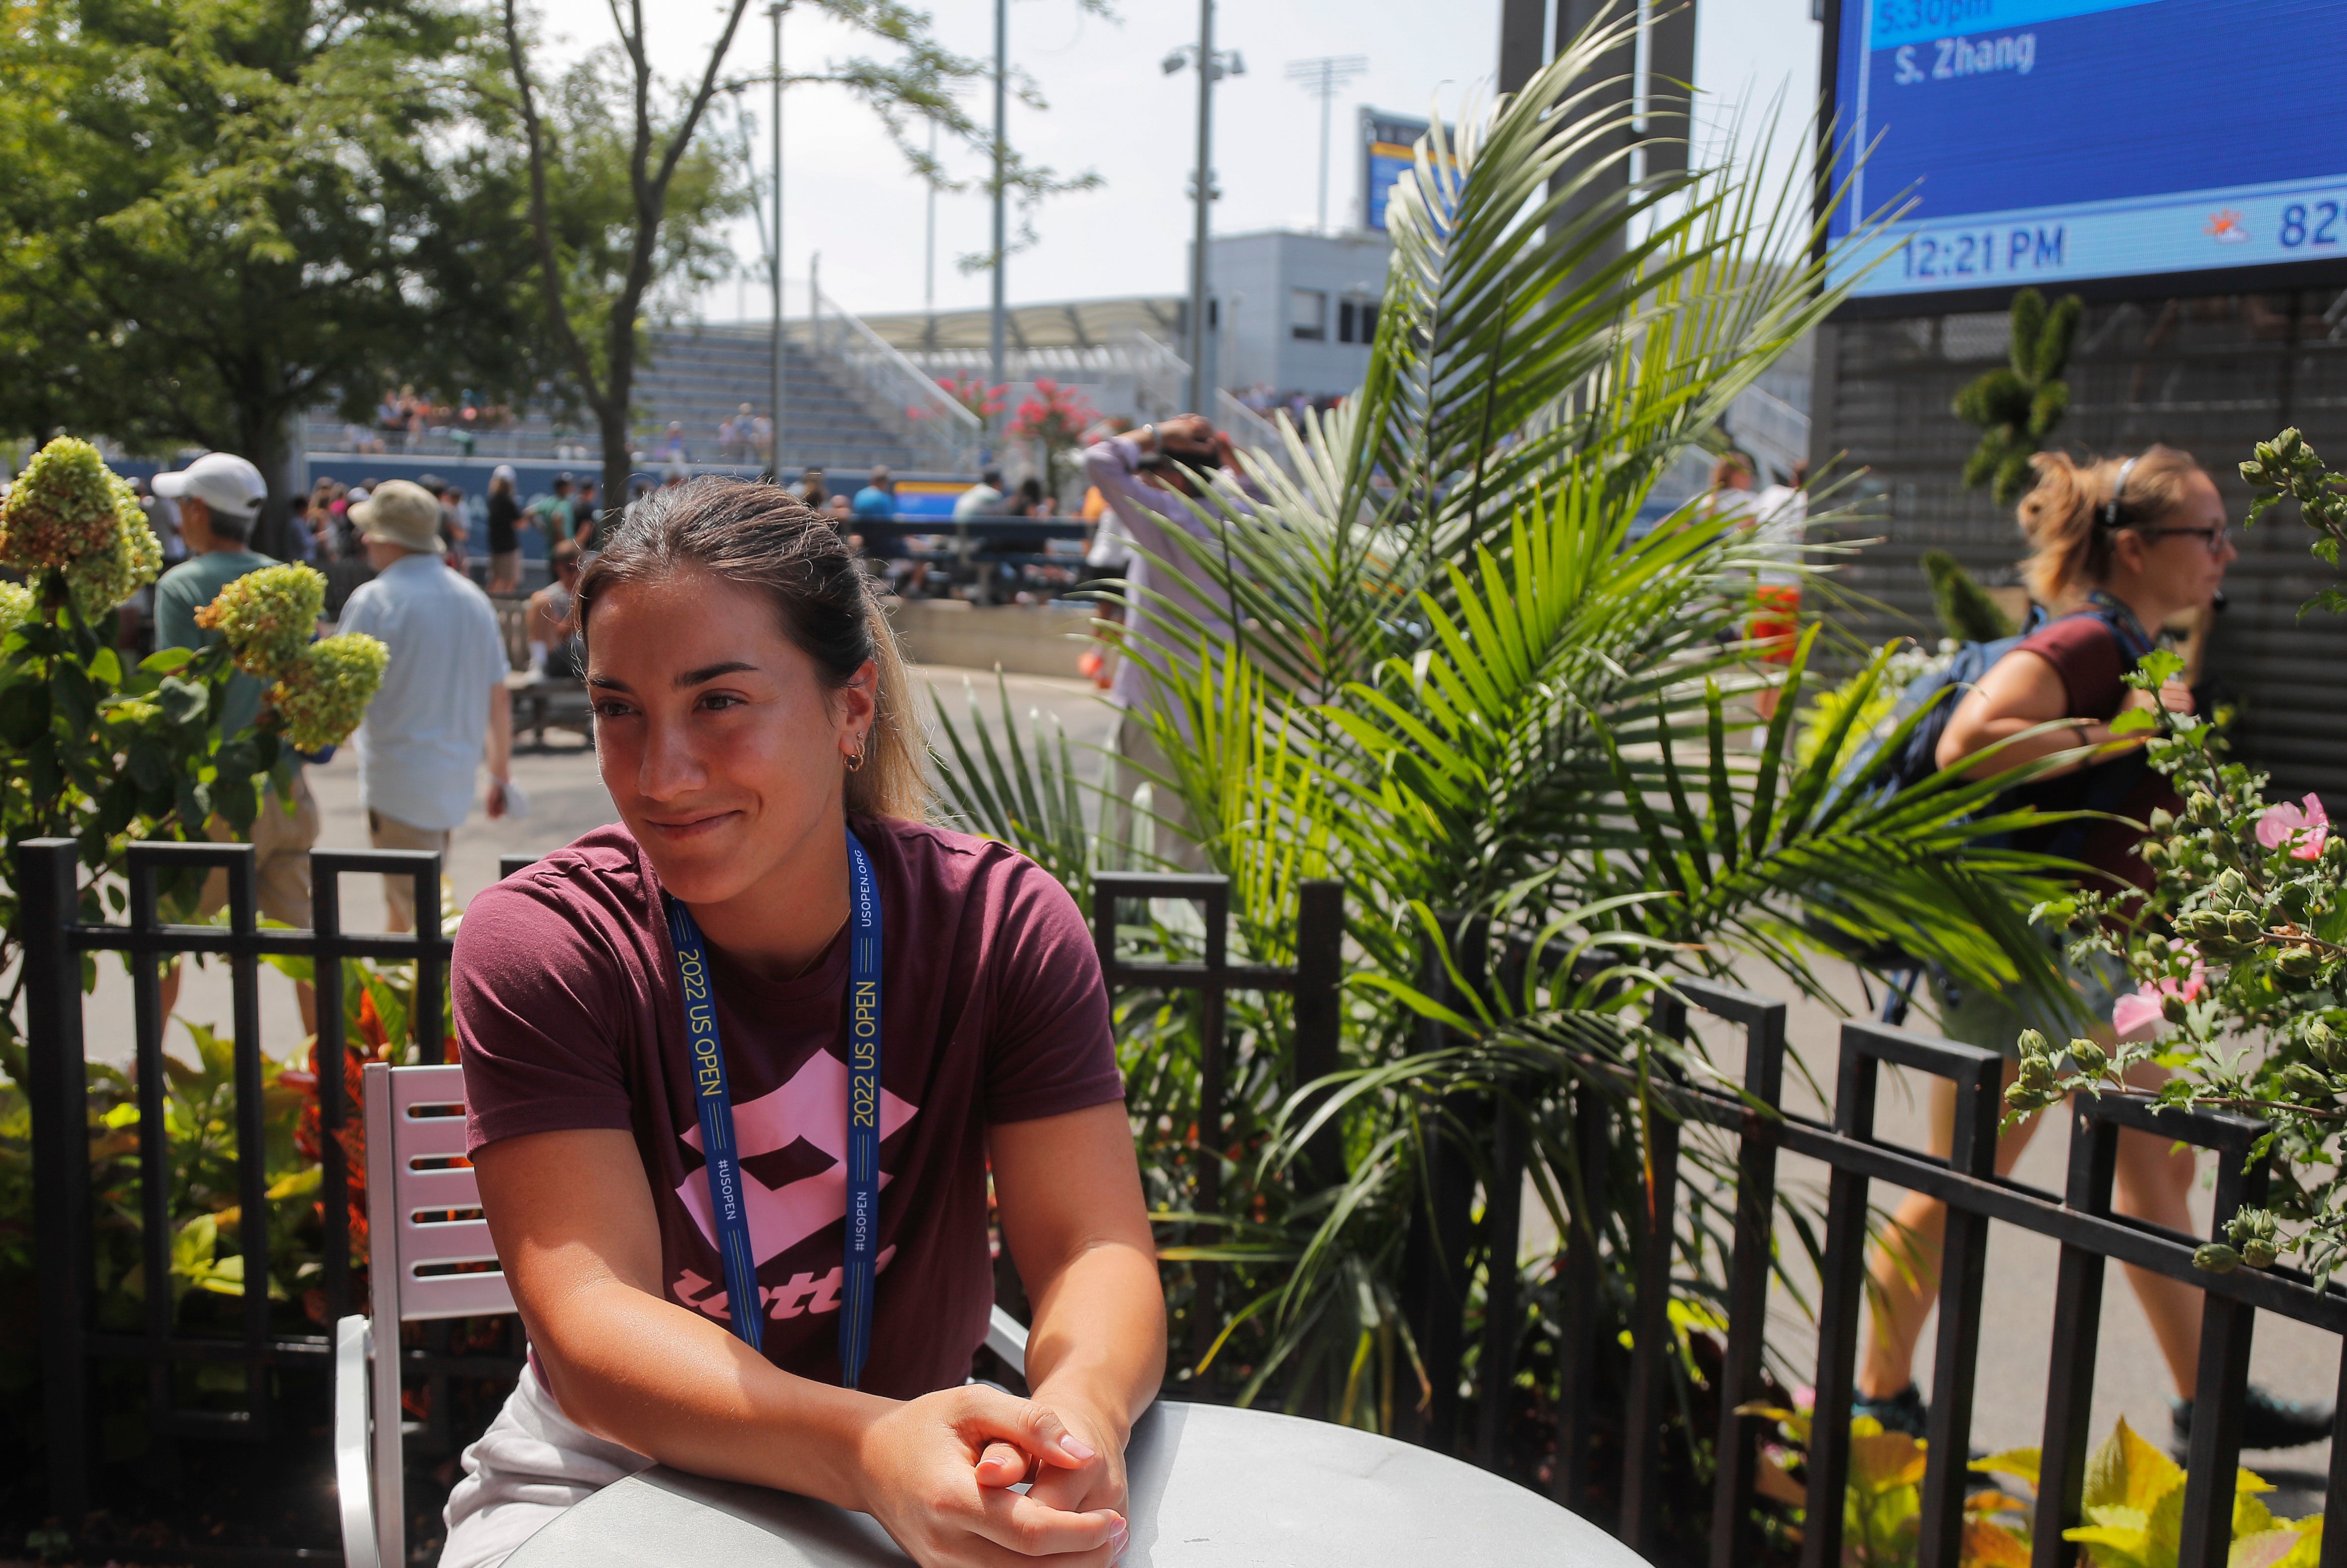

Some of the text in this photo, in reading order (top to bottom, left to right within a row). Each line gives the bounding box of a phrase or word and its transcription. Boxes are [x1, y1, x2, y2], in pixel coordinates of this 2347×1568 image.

[1894, 33, 2037, 85] S. Zhang
[1904, 224, 2065, 278] 12:21 PM
[854, 849, 872, 927] USOPEN.ORG
[678, 949, 722, 1096] 2022 US OPEN
[854, 981, 876, 1127] 2022 US OPEN
[718, 1159, 736, 1220] #USOPEN
[855, 1191, 867, 1251] #USOPEN
